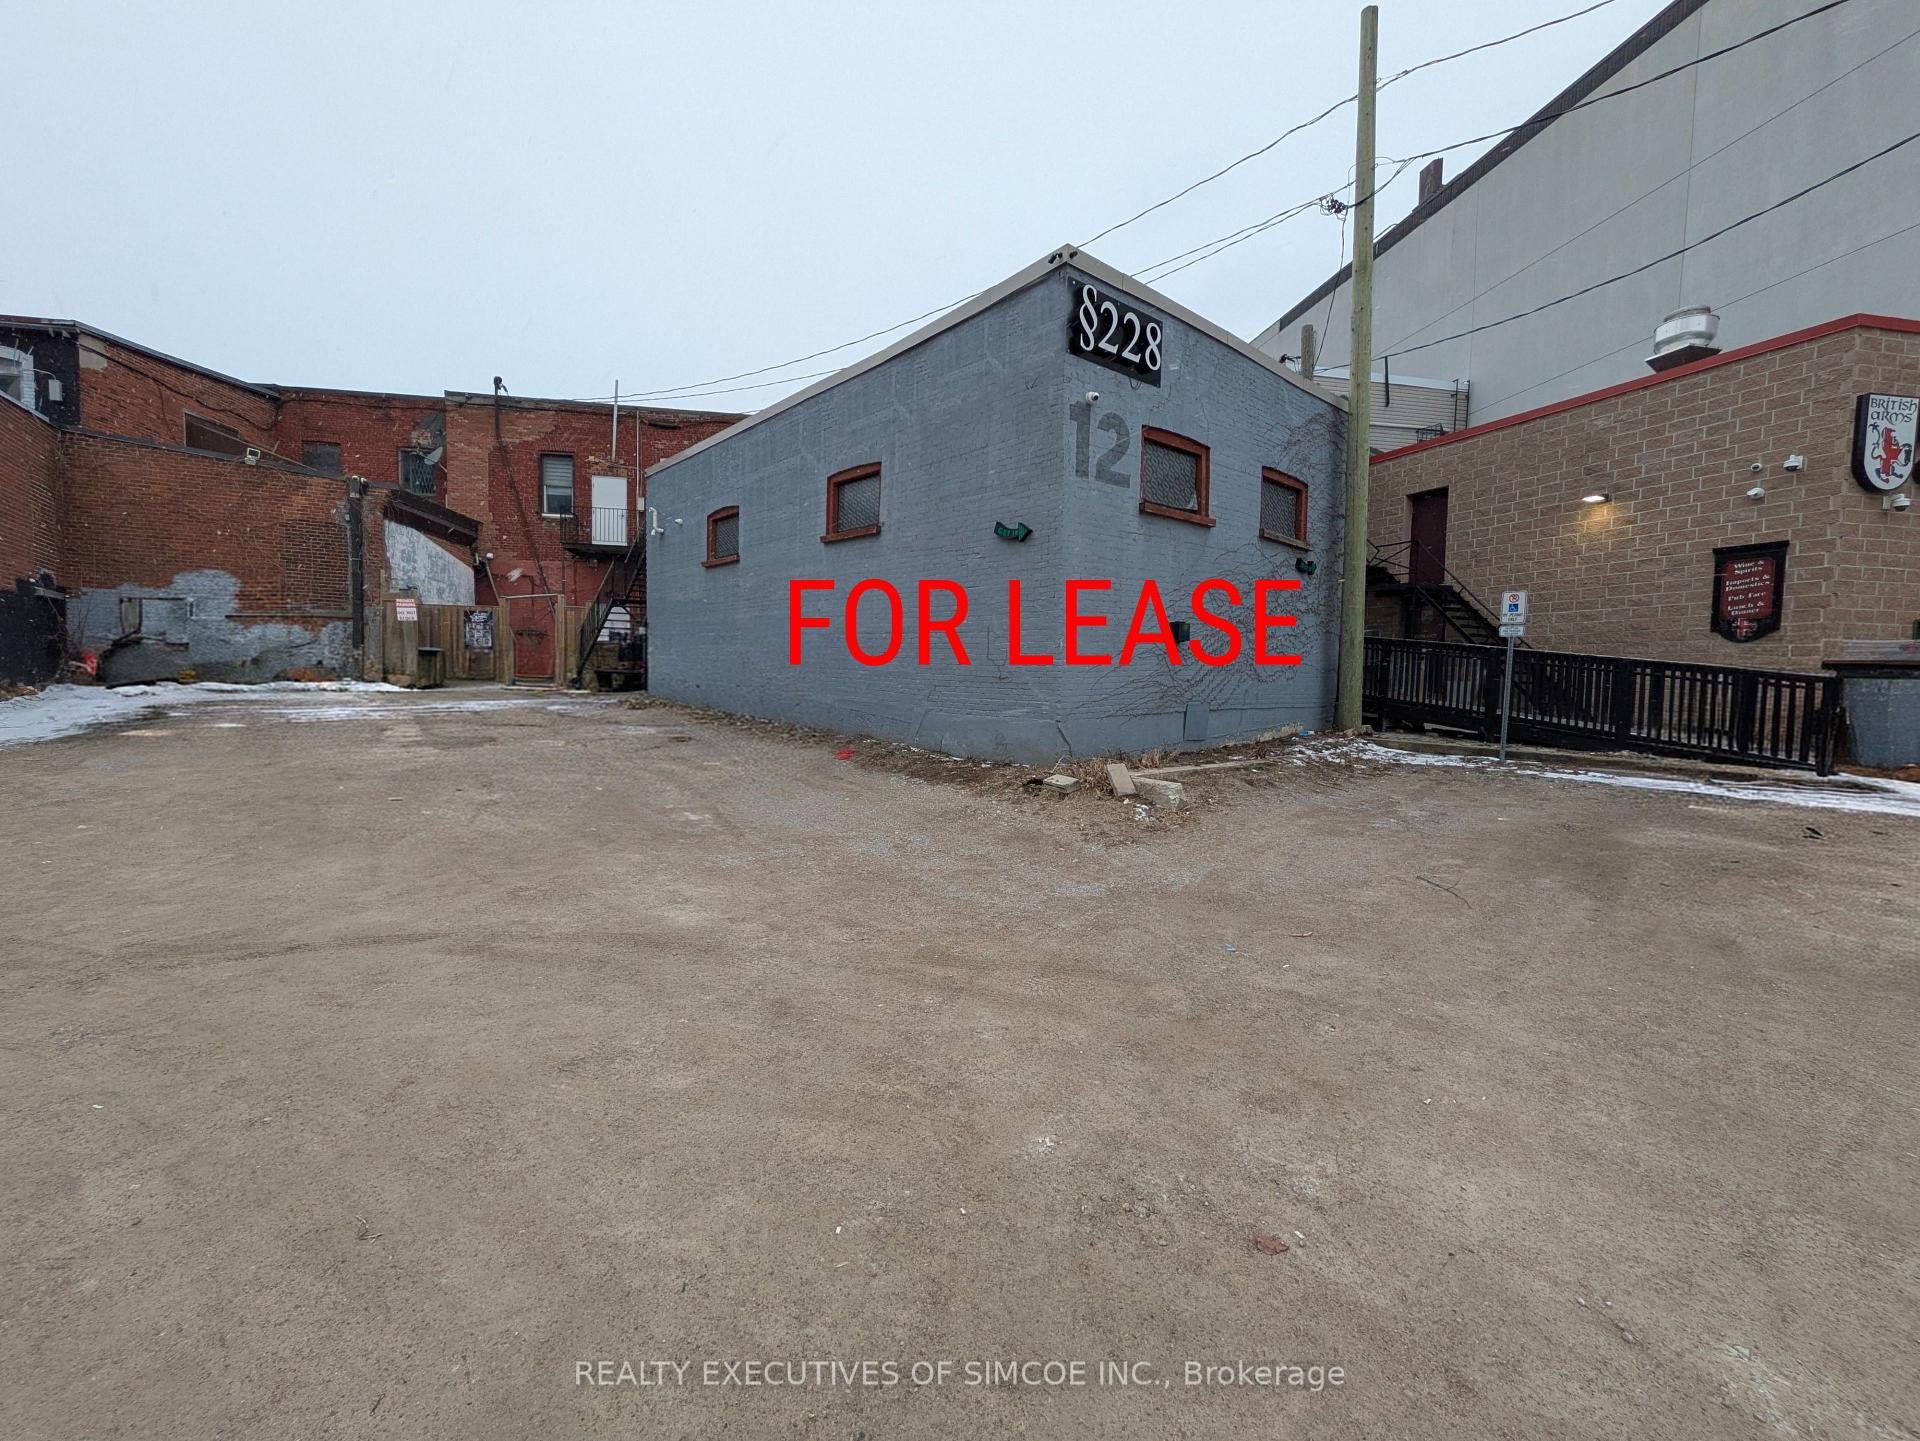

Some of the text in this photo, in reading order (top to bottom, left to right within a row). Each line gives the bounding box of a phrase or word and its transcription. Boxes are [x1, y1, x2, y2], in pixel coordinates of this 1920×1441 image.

[1069, 400, 1131, 489] 12
[1734, 566, 1763, 575] Spirits
[1725, 577, 1760, 586] Imports
[1725, 581, 1770, 592] Domestics
[1728, 594, 1745, 602] Pub
[1727, 603, 1754, 612] Lunch
[1731, 608, 1760, 616] Dinner
